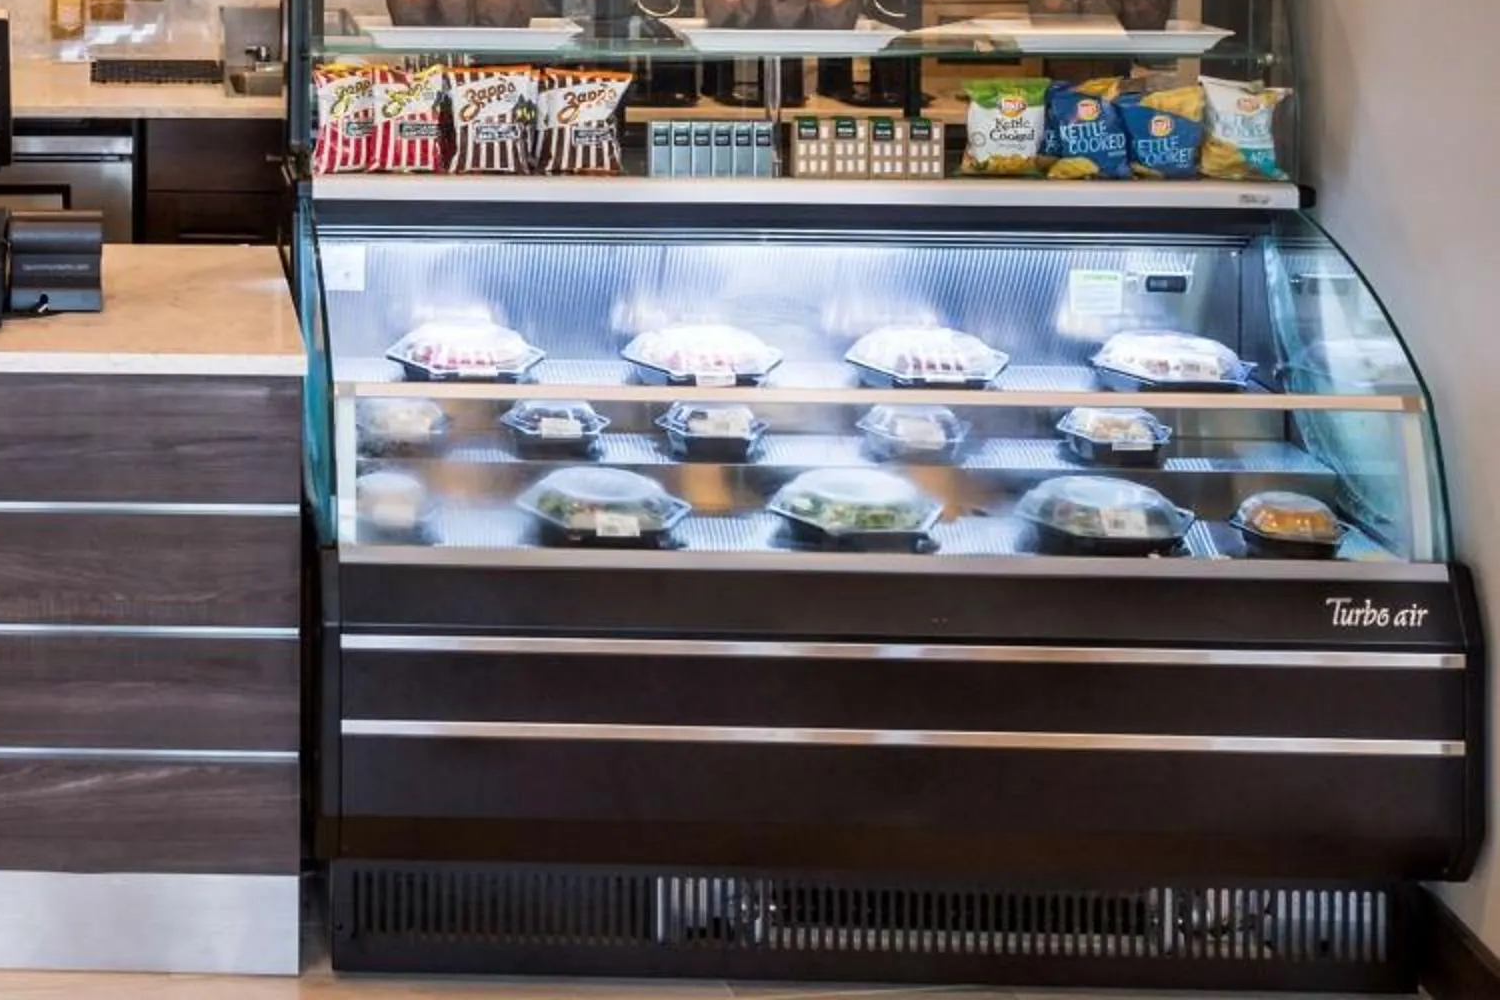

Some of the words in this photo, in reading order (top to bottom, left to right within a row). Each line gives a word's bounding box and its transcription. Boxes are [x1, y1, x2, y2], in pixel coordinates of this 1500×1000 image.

[994, 118, 1031, 131] Kettle
[1060, 121, 1109, 141] KETTLE
[989, 128, 1035, 142] Cooked
[1069, 133, 1125, 154] COOKED
[1325, 597, 1389, 627] Turbo
[1393, 604, 1428, 627] air
